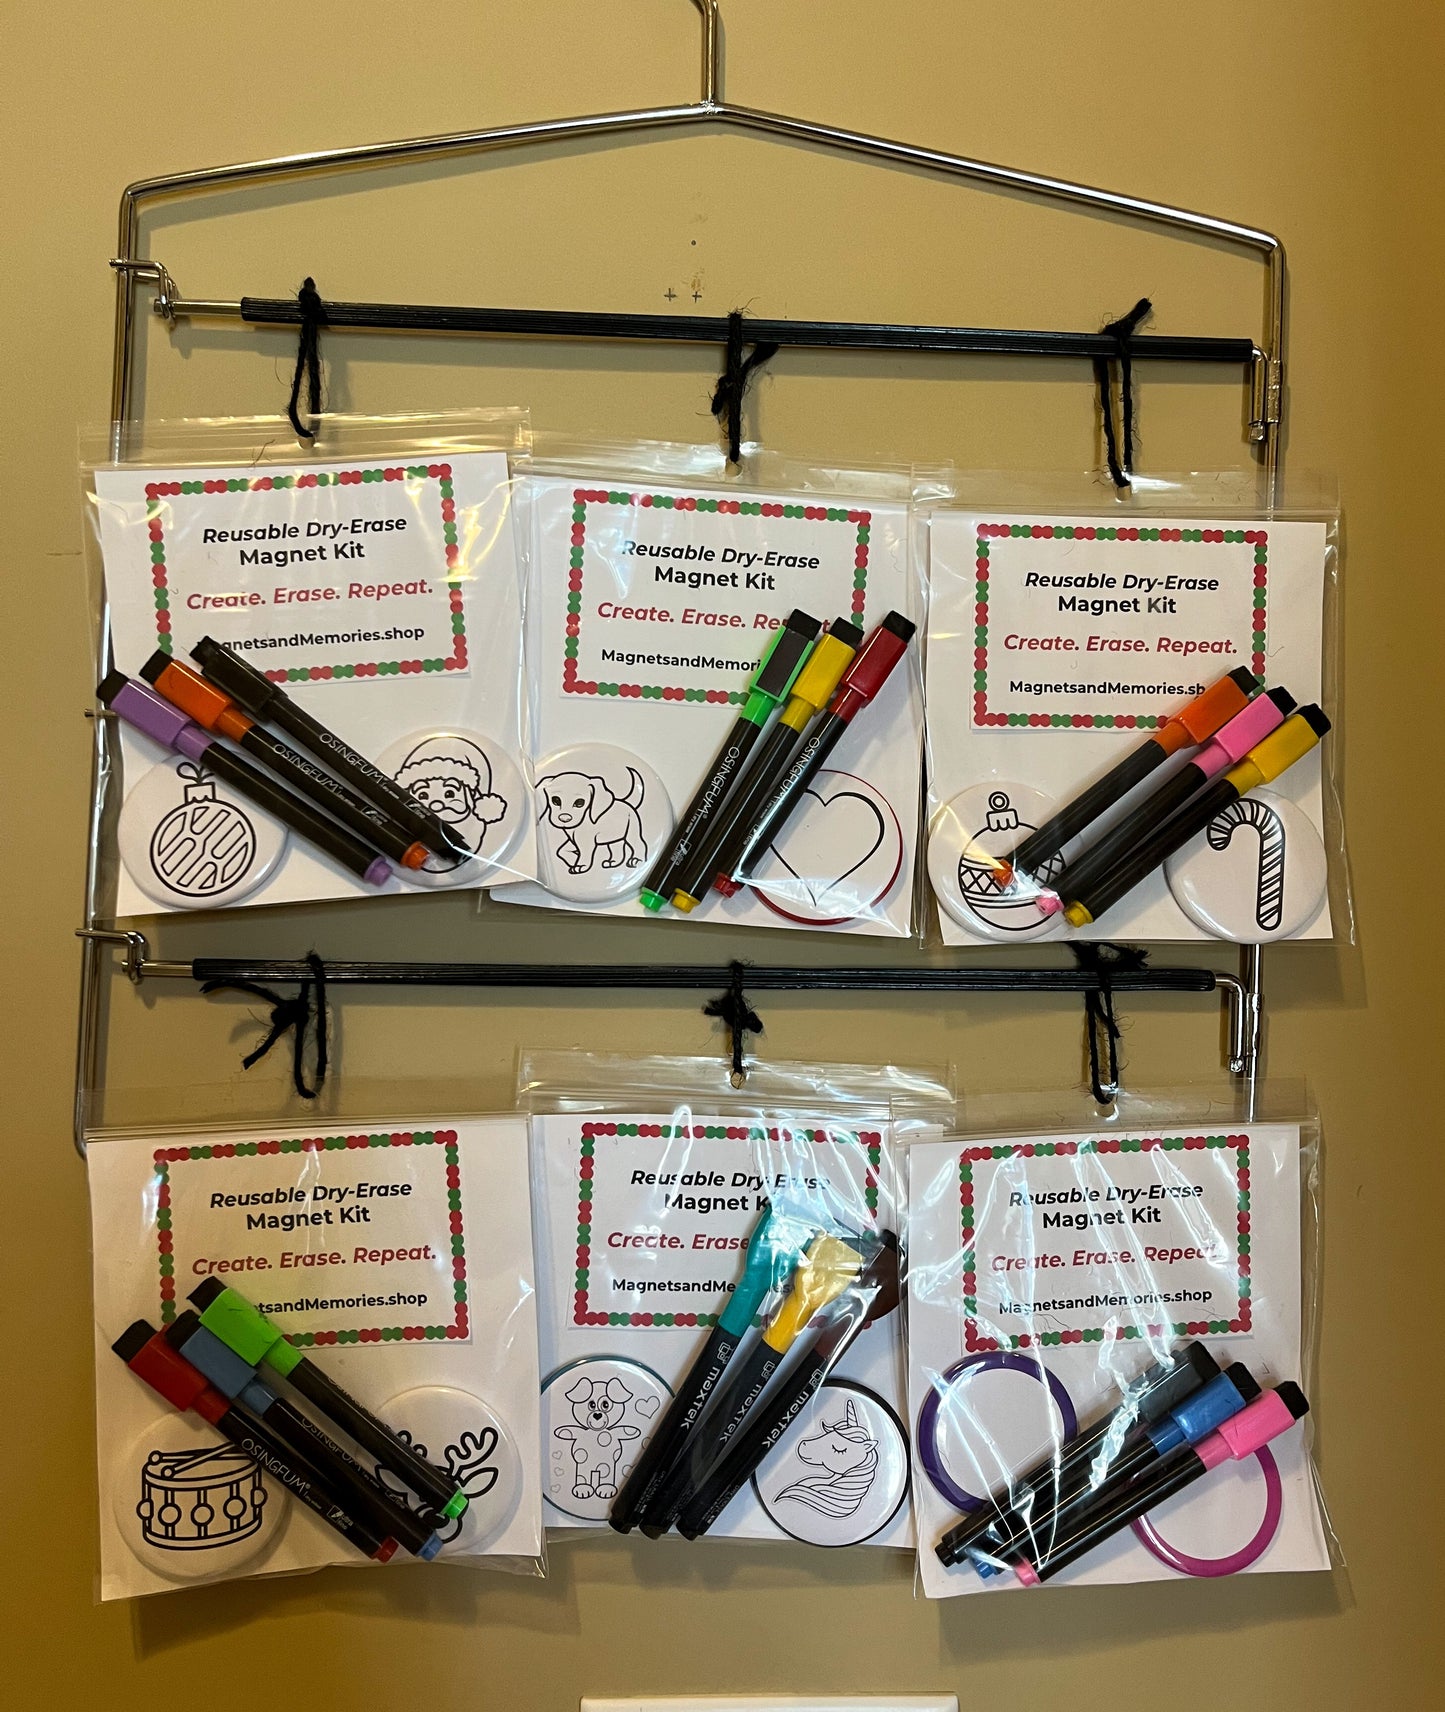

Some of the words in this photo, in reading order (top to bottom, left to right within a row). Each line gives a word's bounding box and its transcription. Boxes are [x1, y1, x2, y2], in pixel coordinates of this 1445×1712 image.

[203, 523, 300, 544] Reusable
[306, 518, 407, 539] Dry-Erase
[240, 545, 327, 567] Magnet
[334, 541, 365, 560] Kit
[622, 540, 716, 562] Reusable
[721, 548, 820, 569] Dry-Erase
[654, 566, 739, 589] Magnet
[745, 573, 776, 591] Kit
[1025, 572, 1117, 589] Reusable
[1123, 574, 1219, 592] Dry-Erase
[187, 591, 266, 610] Create.
[274, 585, 340, 604] Erase.
[348, 579, 433, 600] Repeat.
[1058, 596, 1141, 616] Magnet
[1147, 597, 1177, 614] Kit
[597, 602, 675, 623] Create.
[681, 608, 746, 628] Erase.
[197, 626, 424, 652] netsandMemories.shop
[1004, 634, 1080, 651] Create.
[1086, 636, 1150, 652] Erase.
[1156, 637, 1238, 657] Repeat.
[601, 649, 761, 671] MagnetsandMemori
[1009, 680, 1206, 697] MagnetsandMemories.sh
[273, 744, 338, 794] OSINGFUM
[319, 733, 383, 784] OSINGFUM
[698, 746, 740, 814] OSINGFUM
[631, 1170, 725, 1188] Reusable
[731, 1172, 831, 1191] Dry-Ease
[210, 1187, 306, 1209] Reusable
[312, 1182, 412, 1203] Dry-Erase
[665, 1193, 749, 1213] Magnet
[247, 1210, 333, 1232] Magnet
[340, 1205, 371, 1224] Kit
[1043, 1209, 1125, 1230] Magnet
[1132, 1206, 1161, 1224] Kit
[607, 1232, 685, 1250] Create.
[691, 1234, 750, 1251] Erase
[192, 1256, 273, 1276] Create.
[279, 1251, 346, 1269] Erase.
[353, 1245, 437, 1266] Repeat.
[1072, 1250, 1136, 1267] Erase.
[253, 1292, 428, 1314] tsandMemories.shop
[241, 1438, 307, 1494] OSINGFUM
